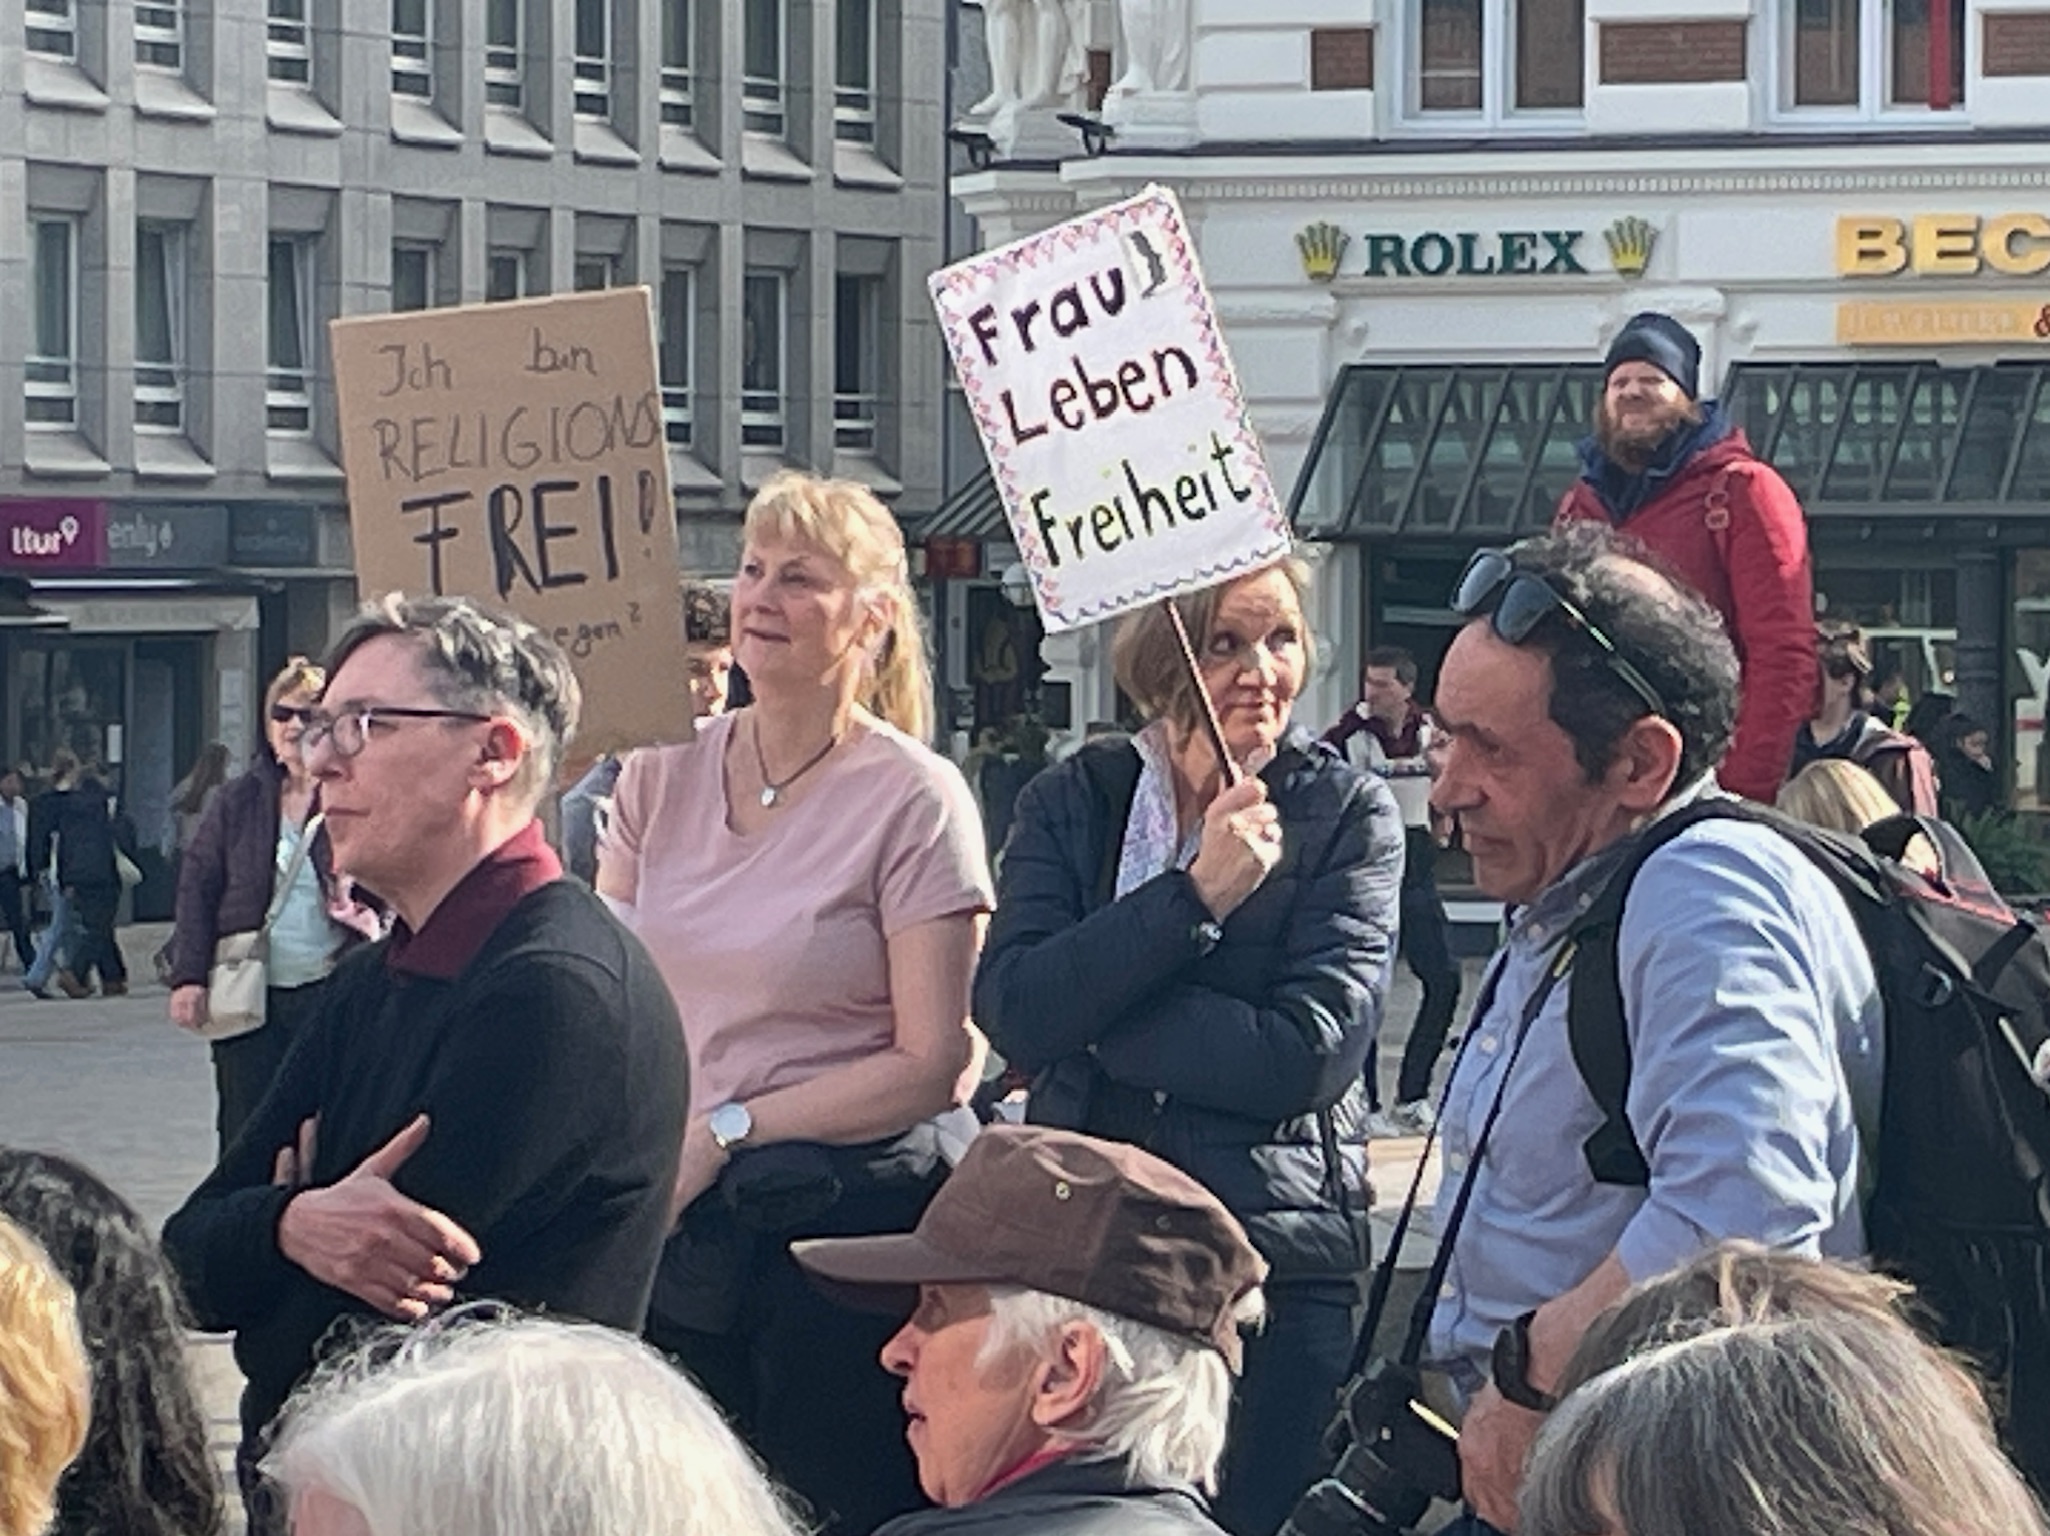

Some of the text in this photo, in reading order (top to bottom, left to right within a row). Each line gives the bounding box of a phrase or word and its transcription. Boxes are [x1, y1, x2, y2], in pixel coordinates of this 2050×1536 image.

[1364, 230, 1588, 276] ROLEX
[1835, 212, 2050, 277] BEC
[379, 327, 598, 397] Ich bin
[966, 266, 1126, 367] Frau
[372, 391, 661, 482] RELIGIONS
[1000, 345, 1199, 446] Leben
[401, 468, 656, 602] FREI!
[1030, 431, 1252, 568] Freiheit
